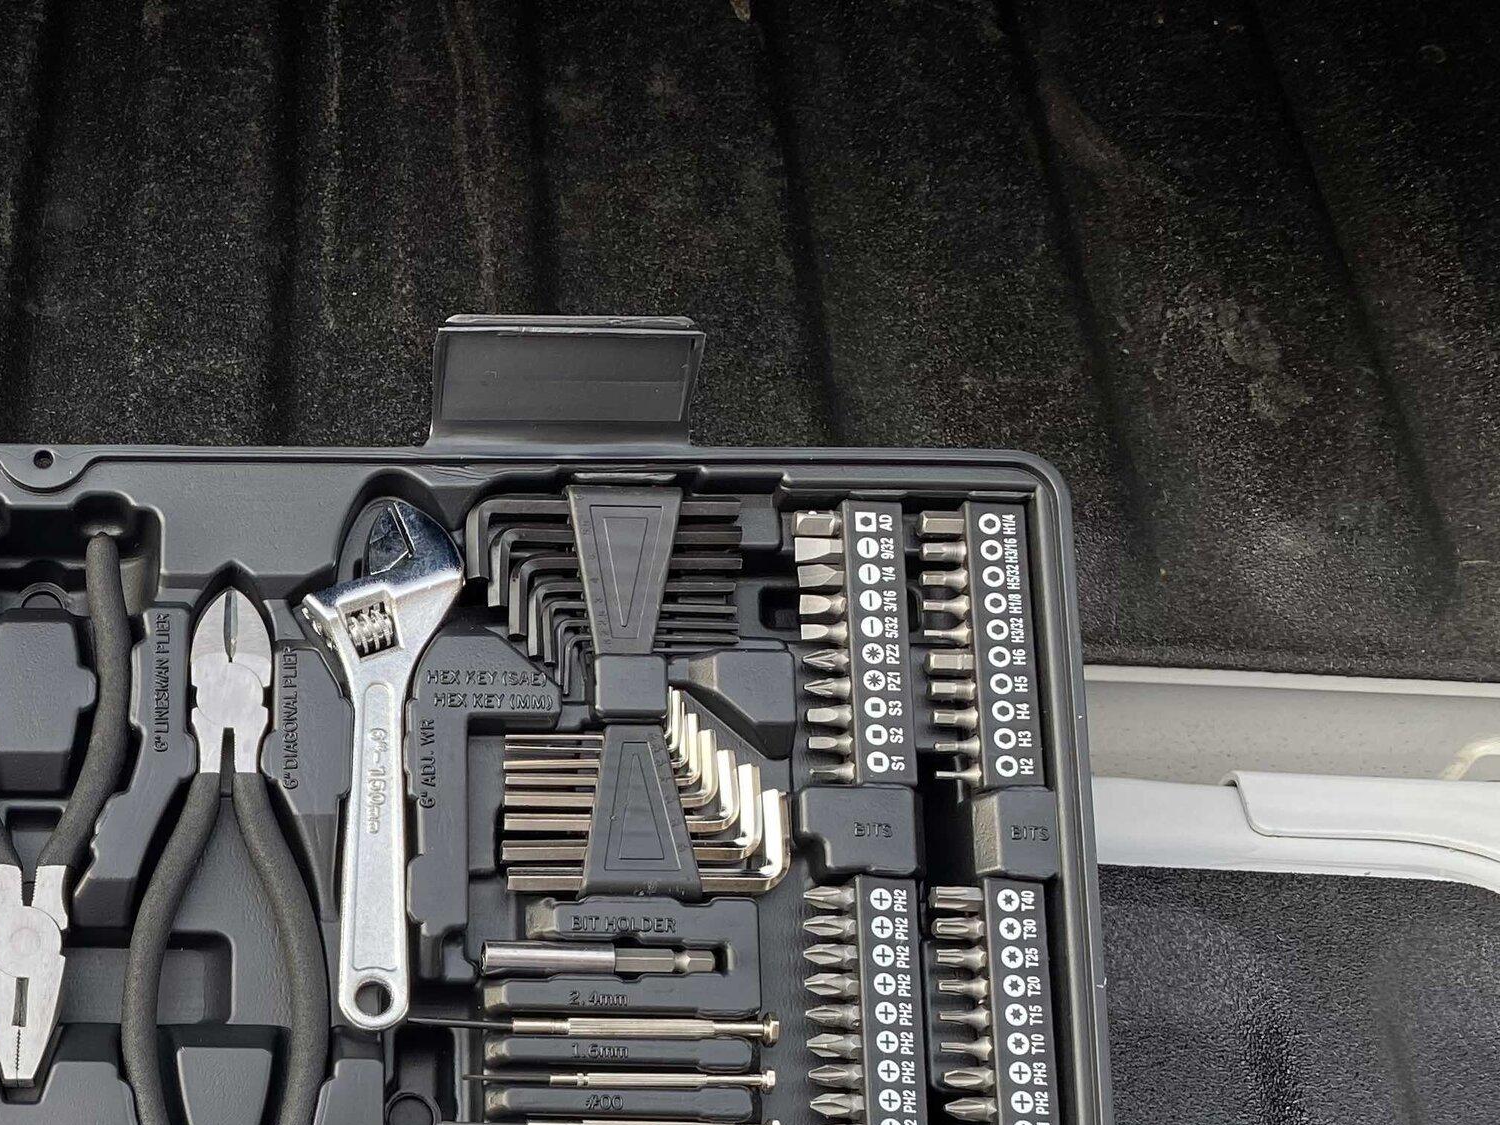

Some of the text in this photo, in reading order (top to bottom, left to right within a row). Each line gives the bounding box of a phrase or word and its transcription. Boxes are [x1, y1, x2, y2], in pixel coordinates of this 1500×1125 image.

[879, 514, 893, 532] AD
[1002, 513, 1016, 535] H1/4
[880, 537, 895, 560] 9/32
[1003, 537, 1018, 564] H3/16
[881, 565, 897, 582] 1/4
[1006, 564, 1020, 590] H5/32
[883, 590, 897, 612] 3/16
[1008, 593, 1022, 615] H1/8
[156, 613, 170, 654] PLIER
[884, 616, 899, 639] 5/32
[1010, 617, 1025, 644] H3/32
[885, 643, 900, 665] PZ2
[1013, 648, 1027, 666] H6
[283, 646, 297, 688] PLIER
[427, 669, 548, 687] HEX KEY (SAE)
[886, 669, 902, 692] PZ1
[1015, 675, 1029, 693] H5
[154, 659, 170, 734] LINESMAN
[433, 693, 554, 711] HEX KEY (MM)
[888, 700, 902, 717] S3
[1016, 702, 1031, 720] H4
[283, 691, 299, 771] DIAGONAL
[420, 719, 435, 746] WR
[889, 727, 904, 744] S2
[1018, 730, 1032, 748] H3
[891, 755, 906, 771] S1
[1020, 758, 1034, 775] H2
[854, 821, 893, 837] BITS
[1010, 825, 1049, 841] BITS
[893, 888, 907, 912] PH2
[1020, 890, 1035, 911] T40
[570, 916, 677, 934] BIT HOLDER
[895, 917, 909, 941] PH2
[1022, 919, 1037, 940] T30
[896, 945, 911, 969] PH2
[1025, 947, 1039, 968] T25
[897, 973, 912, 997] PH2
[1027, 976, 1041, 997] T20
[569, 991, 629, 1008] 2.4mm
[899, 1002, 913, 1026] PH2
[1029, 1004, 1043, 1026] T15
[571, 1043, 629, 1060] 1.6mm
[900, 1031, 915, 1055] PH2
[1031, 1034, 1045, 1055] T10
[901, 1060, 916, 1084] PH2
[1033, 1062, 1048, 1086] PH3
[585, 1095, 624, 1111] #00
[902, 1089, 917, 1114] PH2
[1034, 1091, 1049, 1115] PH2
